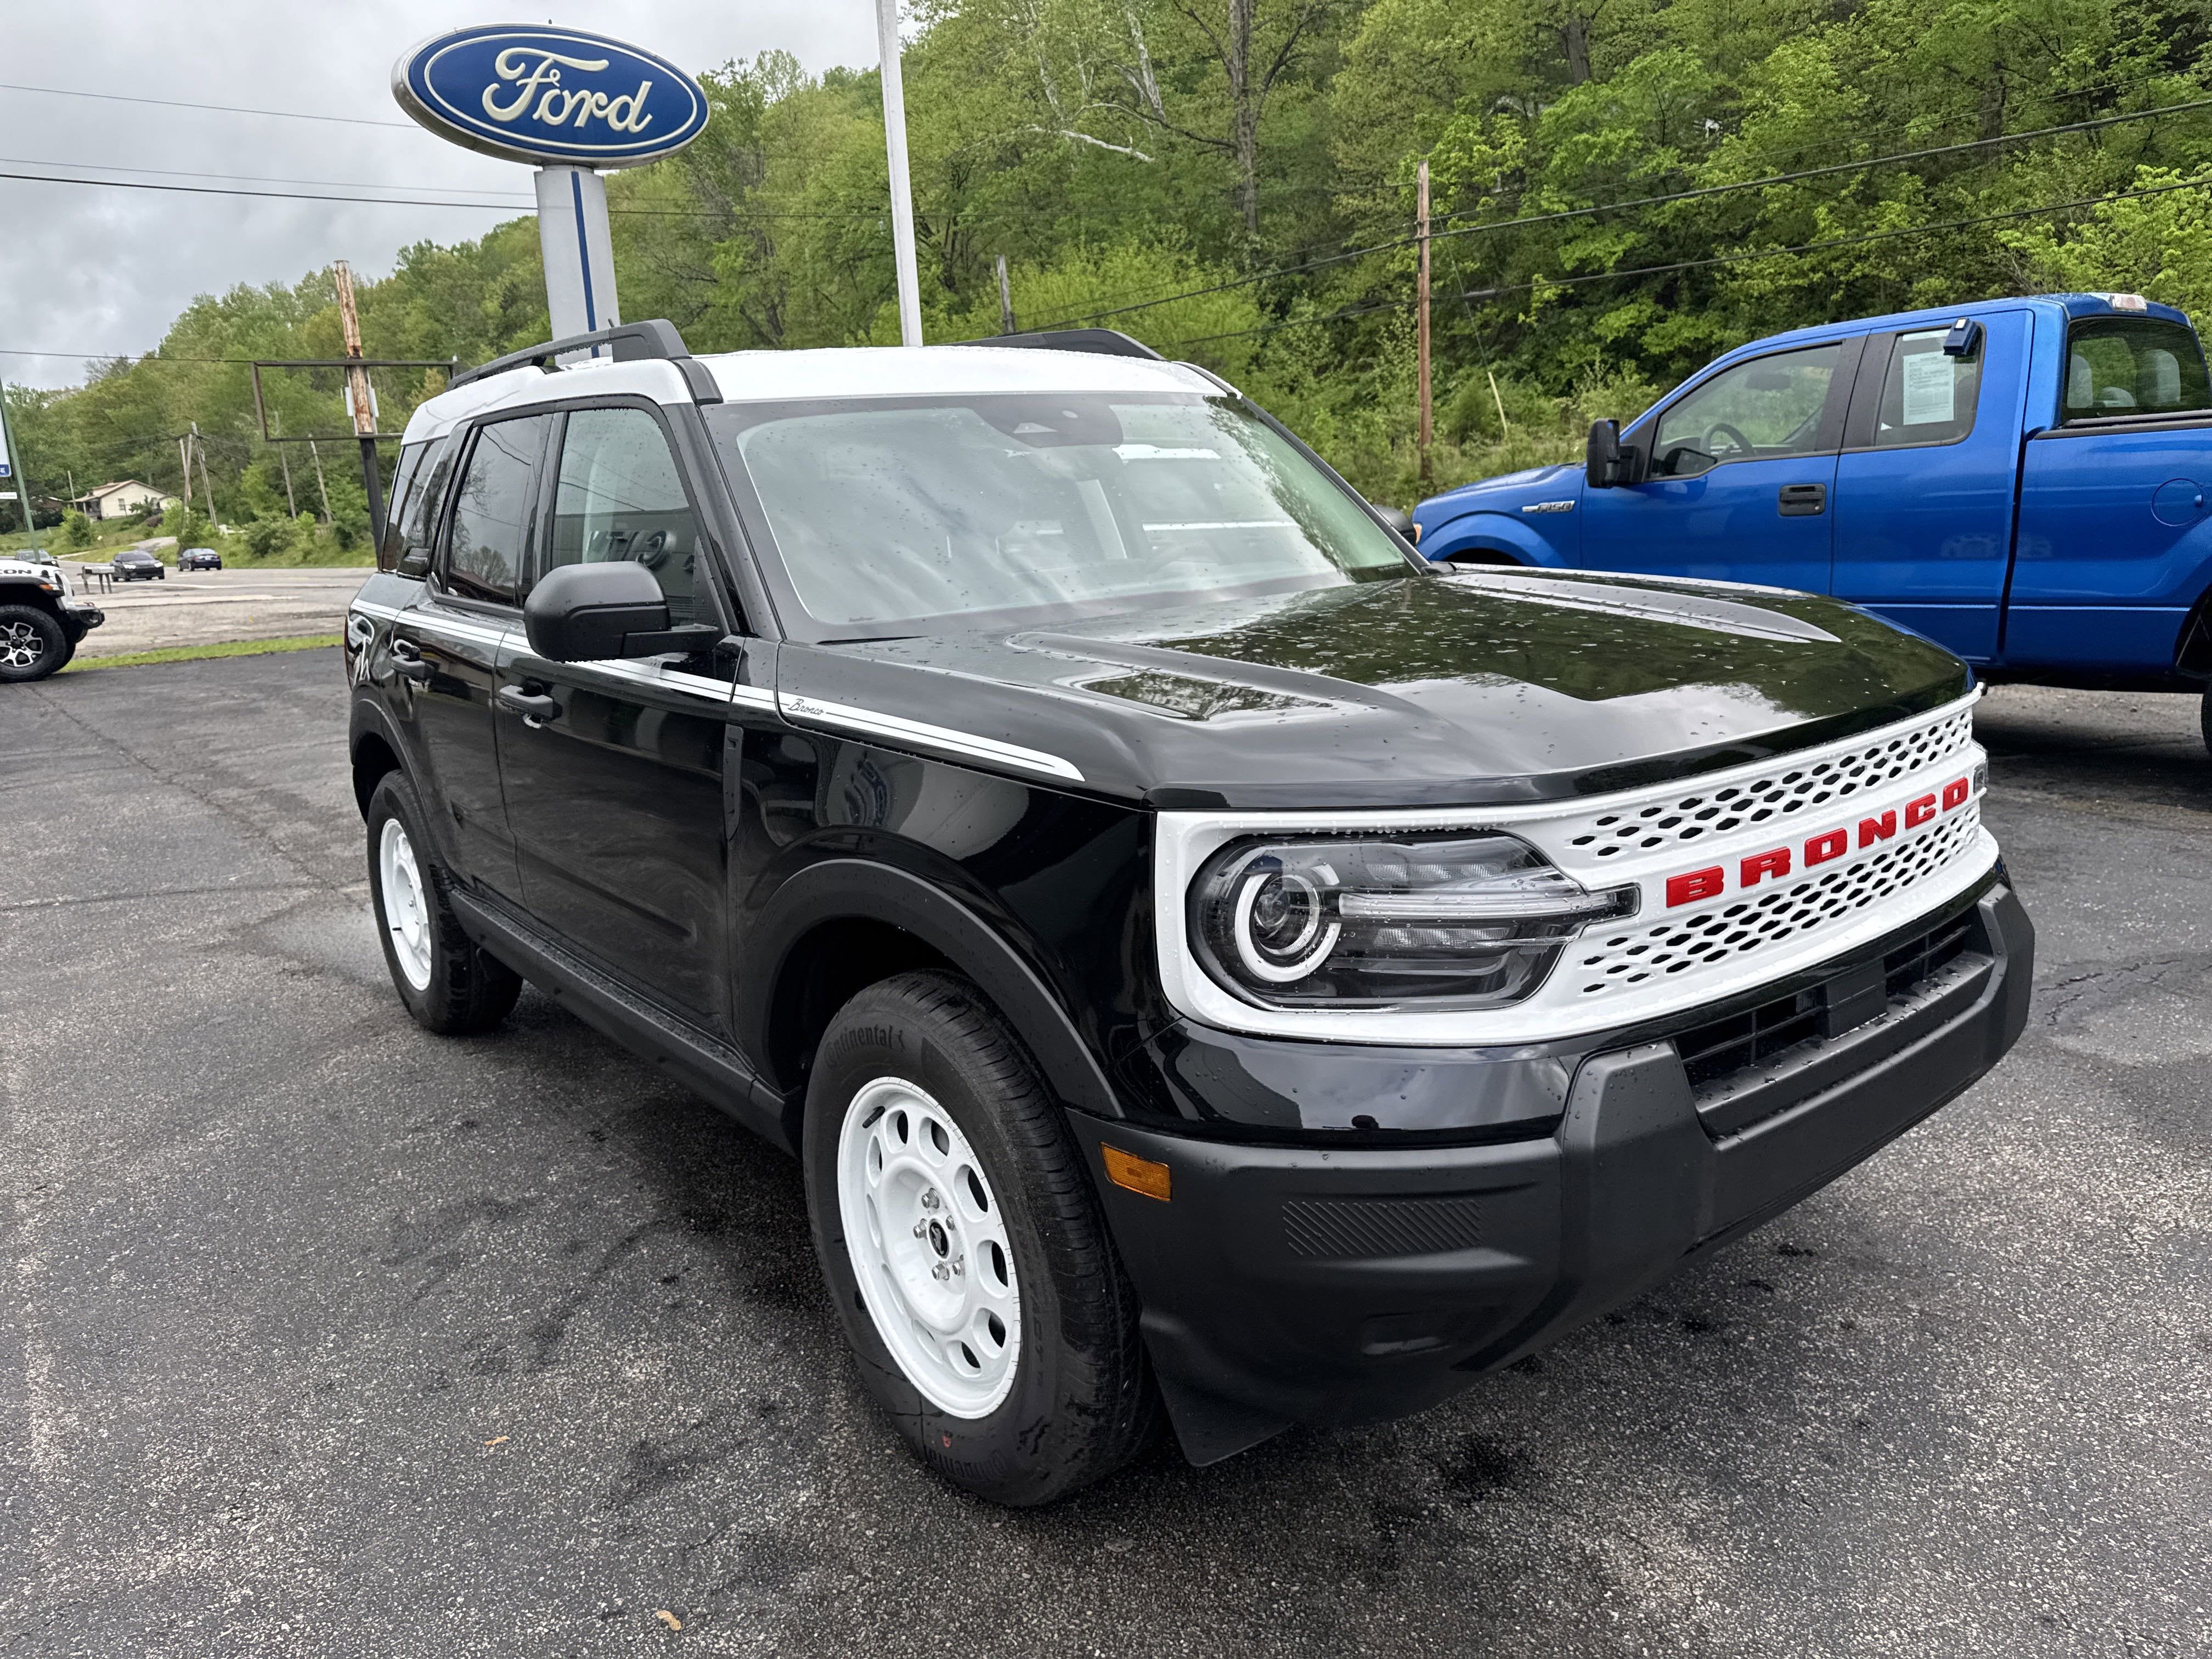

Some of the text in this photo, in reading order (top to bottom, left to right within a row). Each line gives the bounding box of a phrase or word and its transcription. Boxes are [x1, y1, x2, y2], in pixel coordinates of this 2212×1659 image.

[482, 47, 653, 133] Ford
[787, 698, 825, 715] Bronco
[1666, 777, 1968, 909] BRONCO
